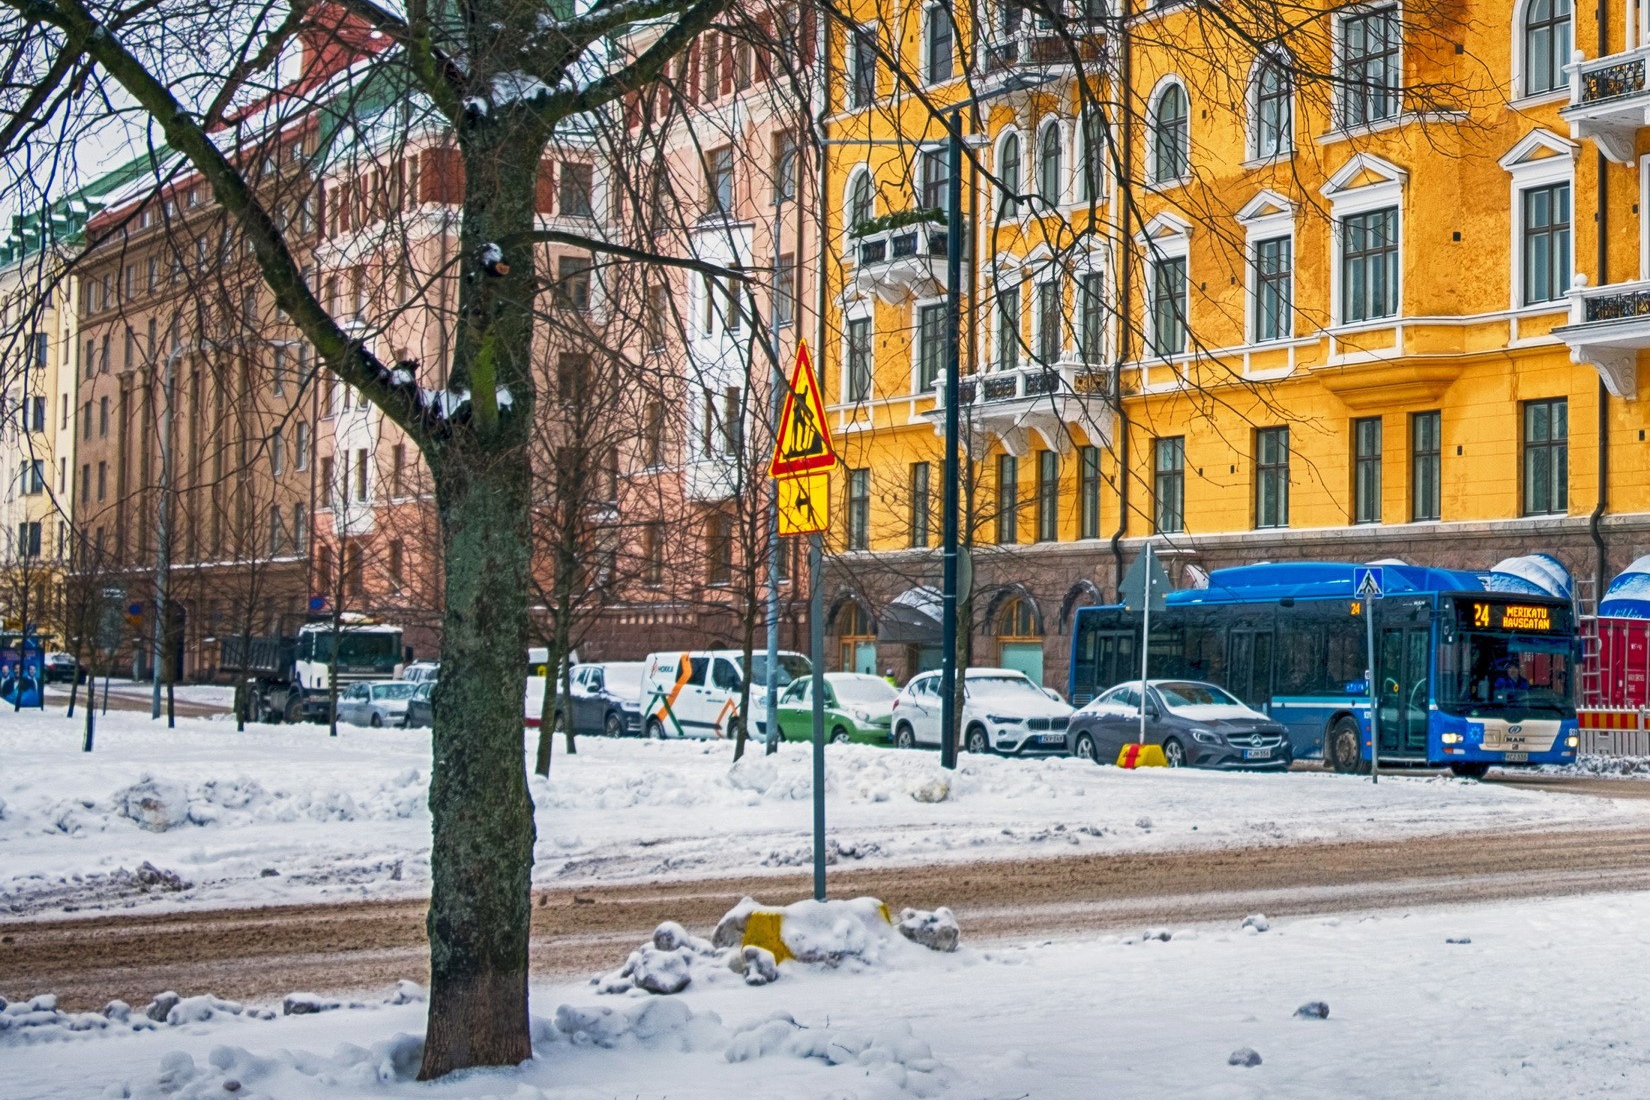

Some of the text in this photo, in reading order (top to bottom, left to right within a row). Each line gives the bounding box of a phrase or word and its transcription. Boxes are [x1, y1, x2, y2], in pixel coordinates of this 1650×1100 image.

[1351, 603, 1361, 615] 24
[1474, 604, 1547, 627] 24 MERIKATU
[1503, 616, 1550, 629] HAVSGATAN
